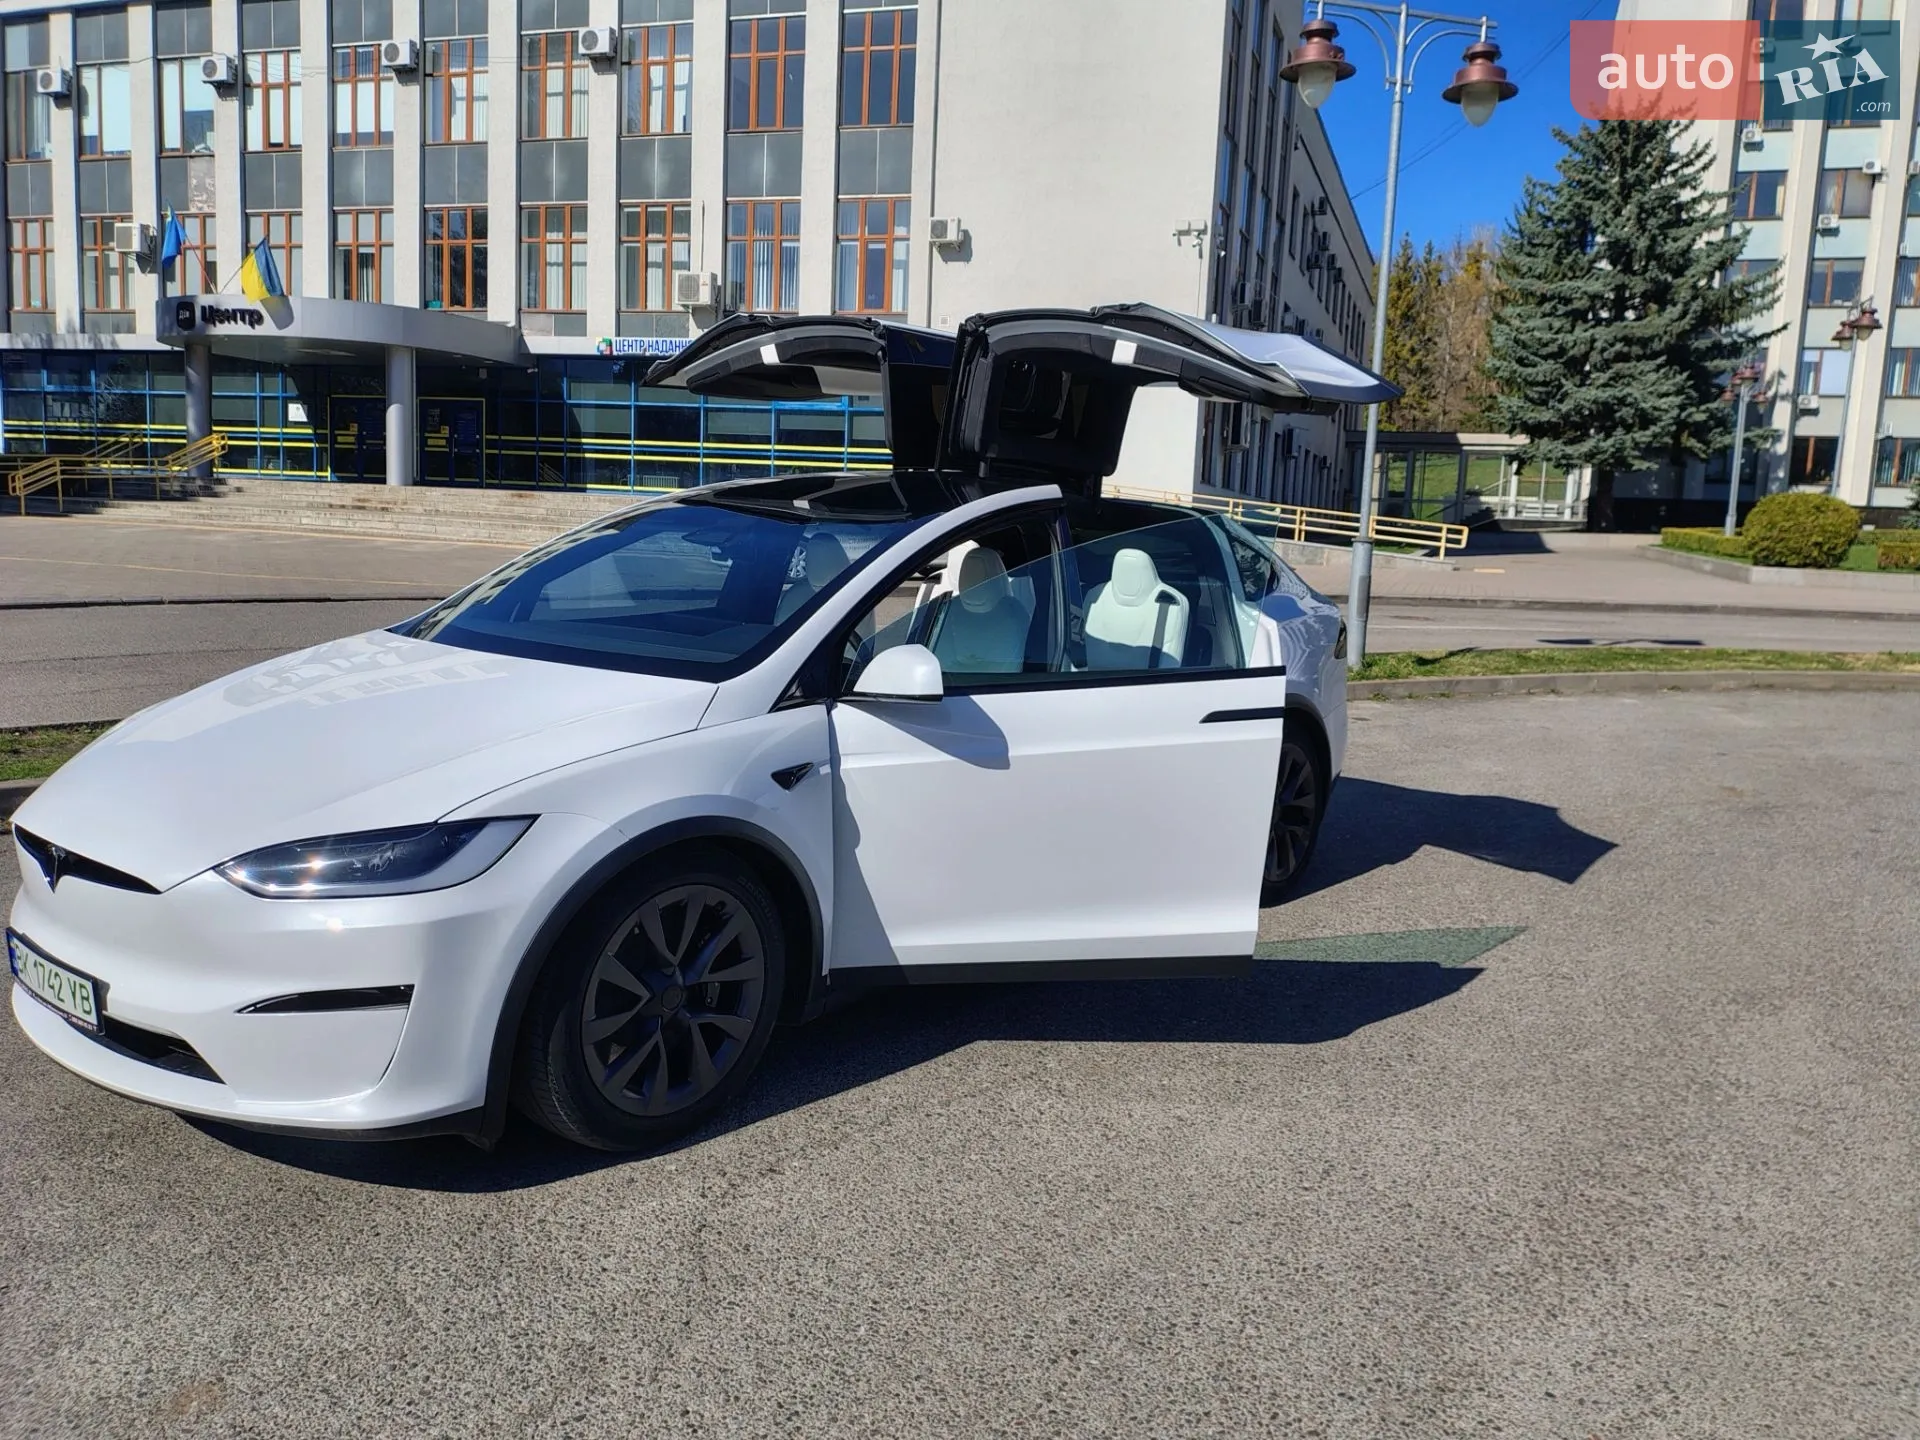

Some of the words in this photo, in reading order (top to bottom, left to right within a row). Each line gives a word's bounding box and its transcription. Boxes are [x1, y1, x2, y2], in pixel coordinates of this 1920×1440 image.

[200, 304, 264, 329] Центр
[615, 339, 645, 354] ЦЕНТР
[647, 339, 694, 354] НАДАНН
[34, 959, 66, 1004] 1742
